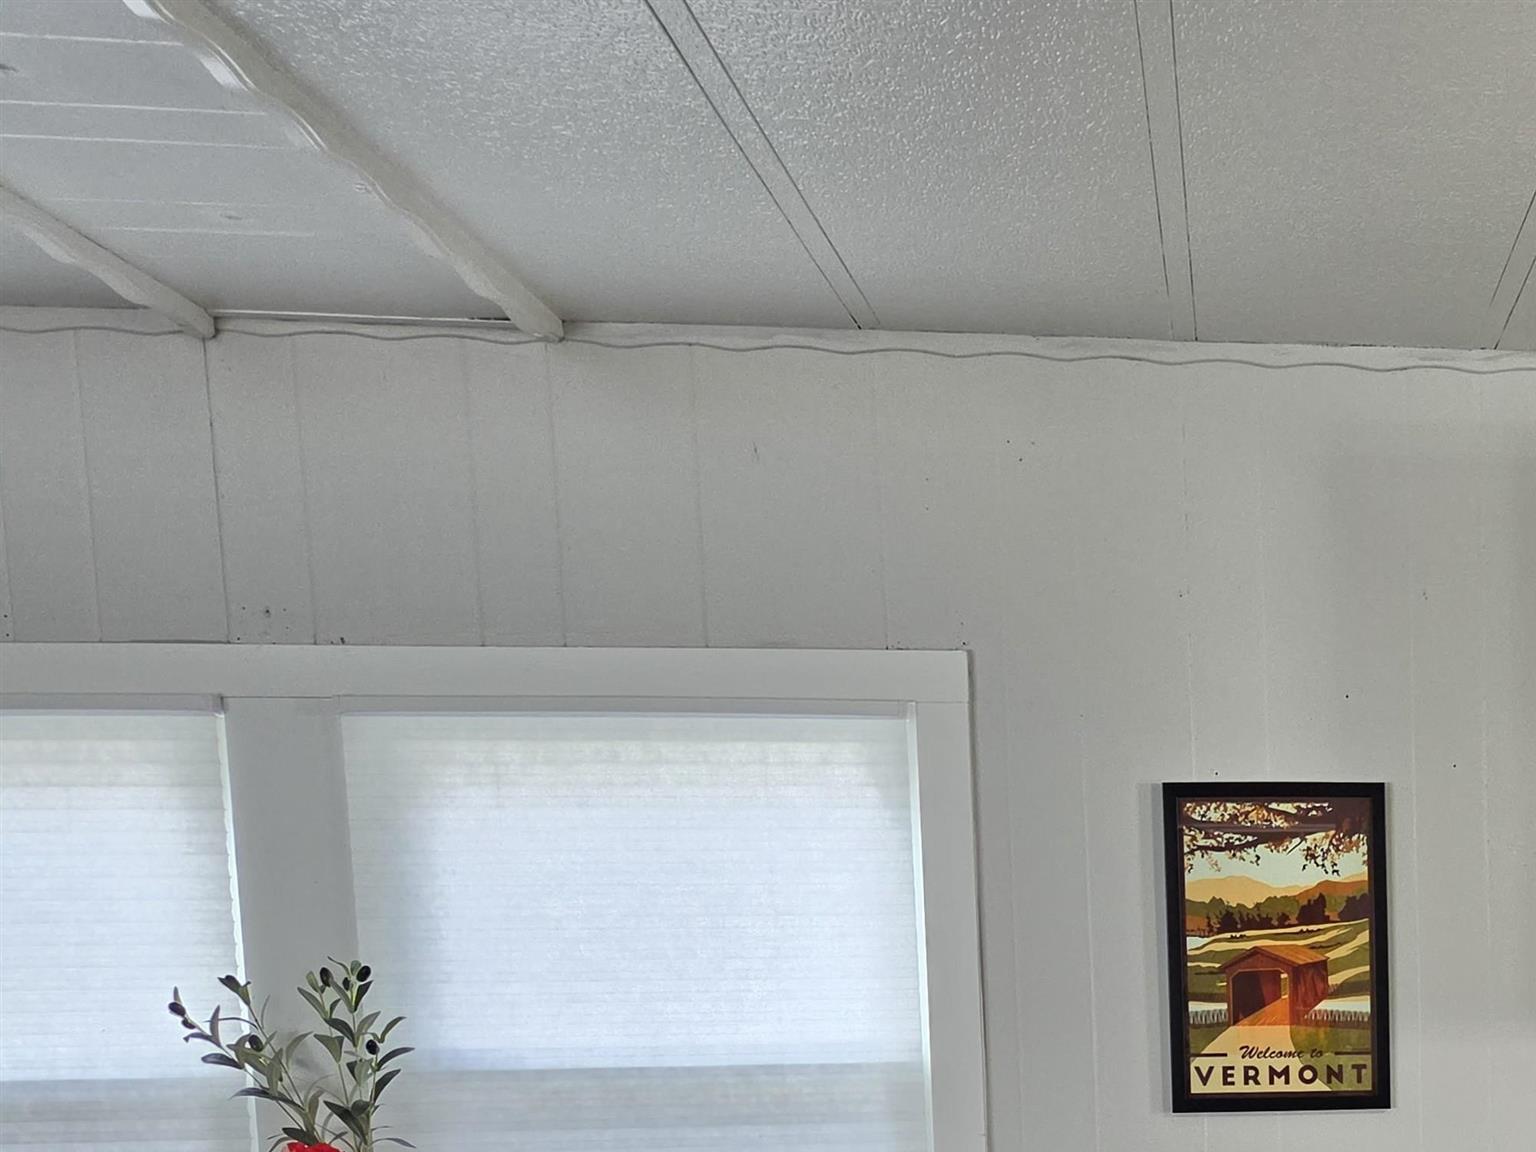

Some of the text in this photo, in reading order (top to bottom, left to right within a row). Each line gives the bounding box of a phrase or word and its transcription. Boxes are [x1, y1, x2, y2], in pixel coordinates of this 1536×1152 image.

[1239, 1045, 1325, 1059] Welcome to
[1194, 1063, 1368, 1086] VERMONT
